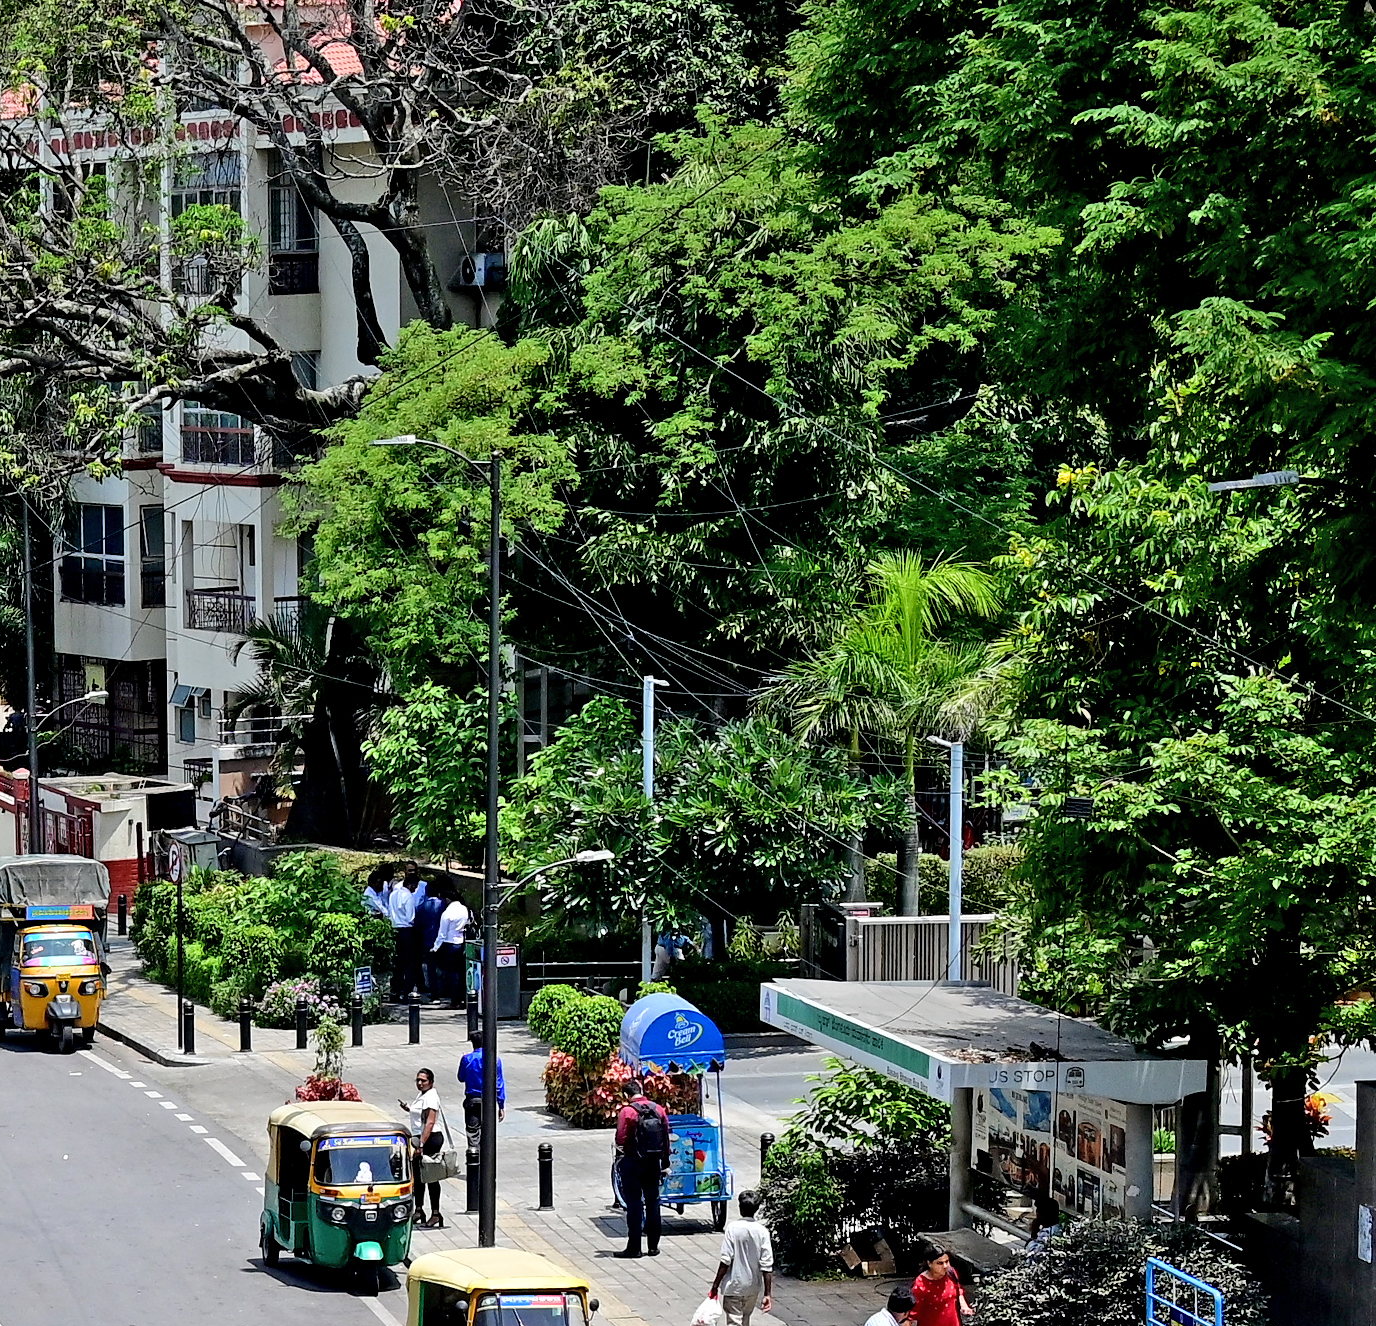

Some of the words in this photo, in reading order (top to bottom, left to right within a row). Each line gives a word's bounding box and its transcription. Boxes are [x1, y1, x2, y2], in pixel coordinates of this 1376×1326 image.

[668, 1026, 696, 1039] Cream
[675, 1034, 691, 1047] Bell
[1013, 1070, 1055, 1083] STOP
